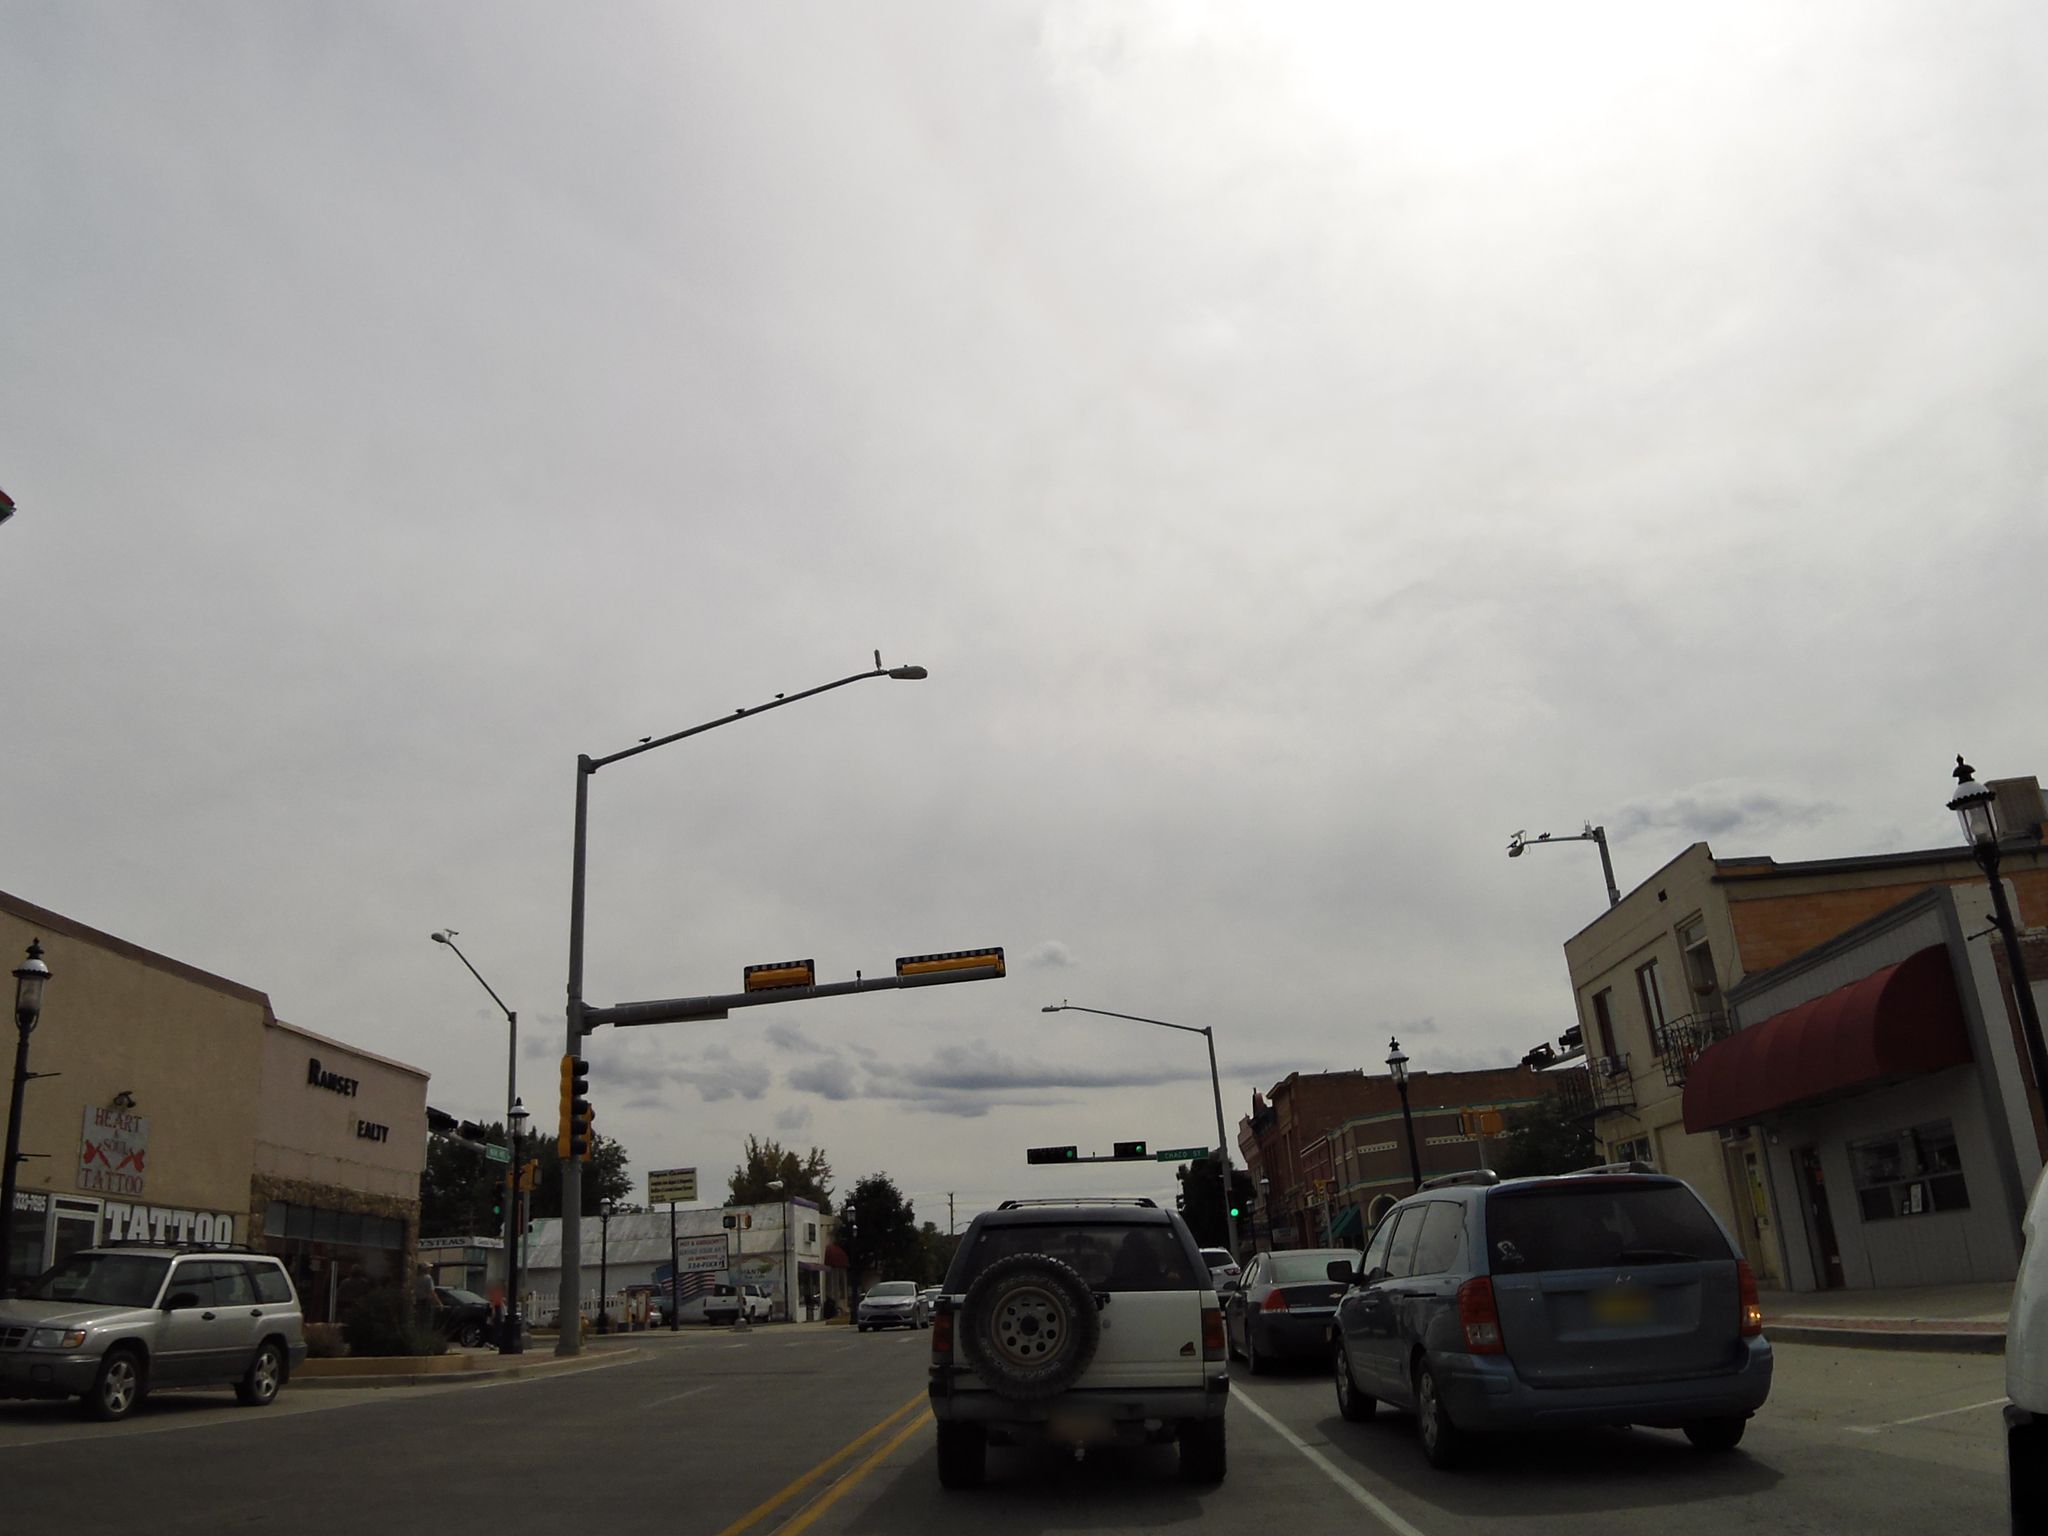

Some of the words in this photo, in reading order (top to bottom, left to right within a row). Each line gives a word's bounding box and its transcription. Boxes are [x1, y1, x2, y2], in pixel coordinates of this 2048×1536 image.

[95, 1108, 143, 1133] HEART
[103, 1139, 129, 1156] SOUL
[82, 1168, 144, 1194] TATTOO
[106, 1201, 233, 1249] TATTOO
